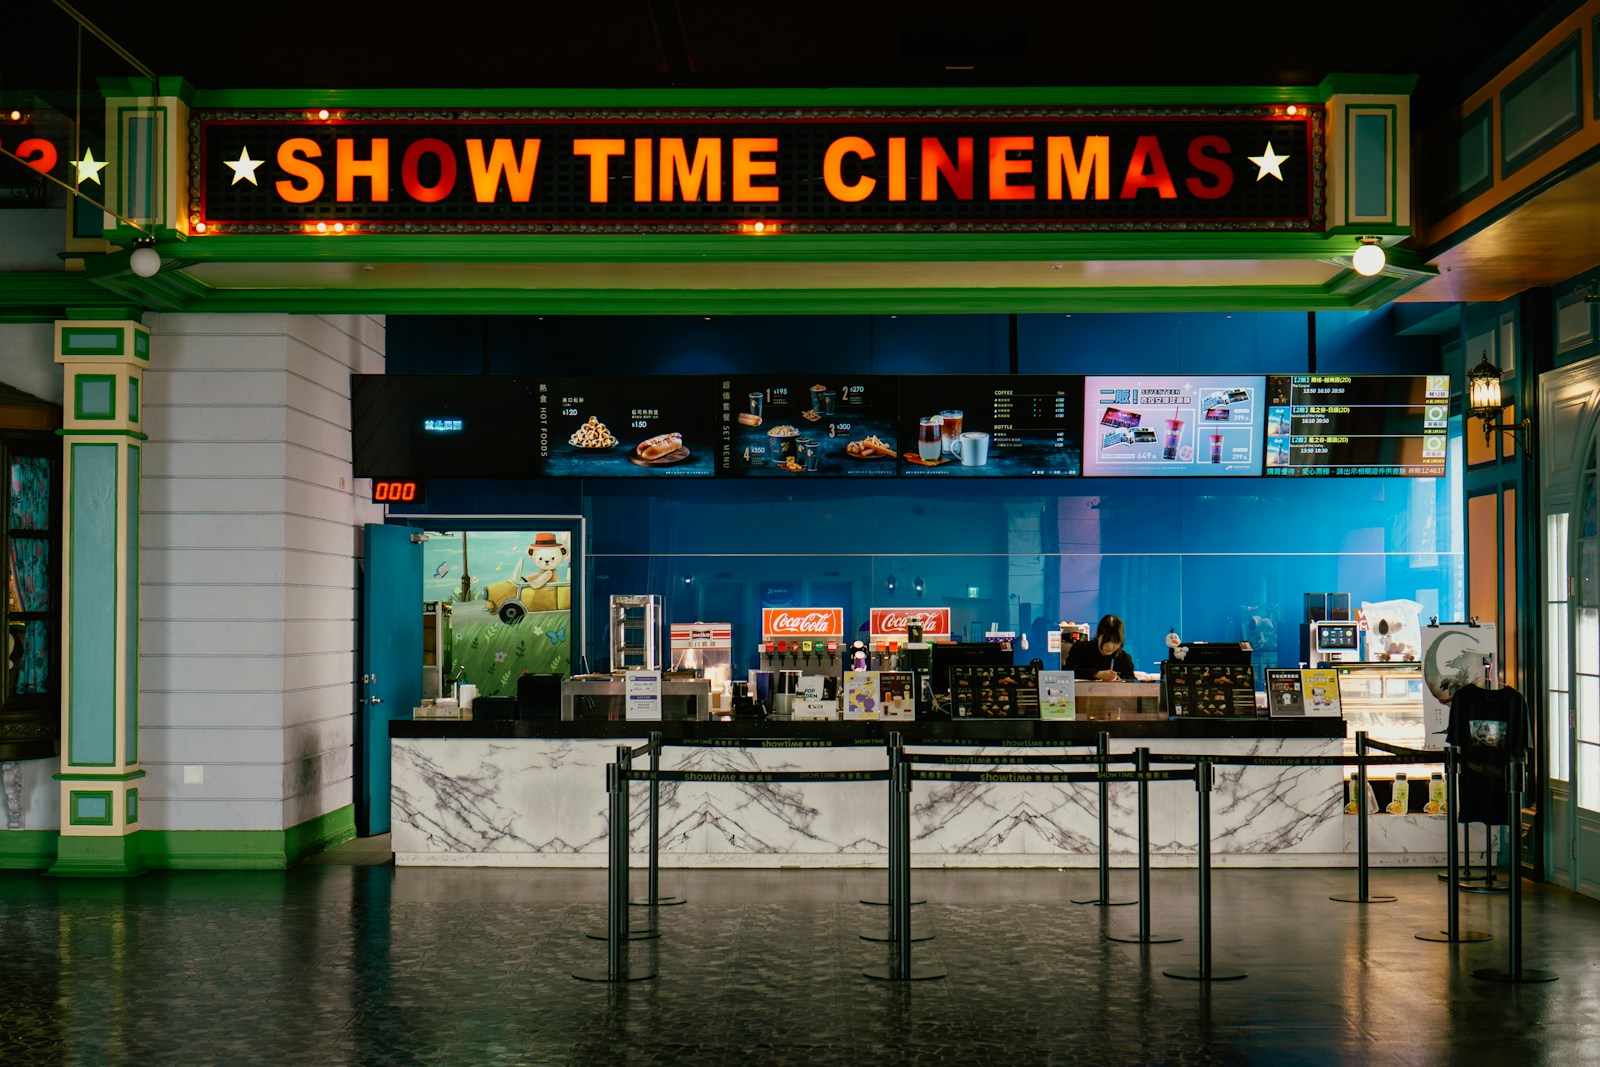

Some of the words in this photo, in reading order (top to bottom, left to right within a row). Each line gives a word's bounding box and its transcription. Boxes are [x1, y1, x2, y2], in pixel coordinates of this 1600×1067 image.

[275, 137, 541, 204] SHOW
[573, 138, 780, 203] TIME
[823, 135, 1234, 202] CINEMAS
[766, 388, 770, 403] 1
[842, 386, 848, 400] 2
[829, 424, 835, 438] 3
[744, 447, 750, 461] 4
[375, 482, 416, 500] 000
[773, 612, 833, 632] Coca-Cola
[944, 756, 992, 764] showtime
[1254, 756, 1300, 765] showtime
[684, 772, 736, 782] showtime
[980, 773, 1033, 782] showtime
